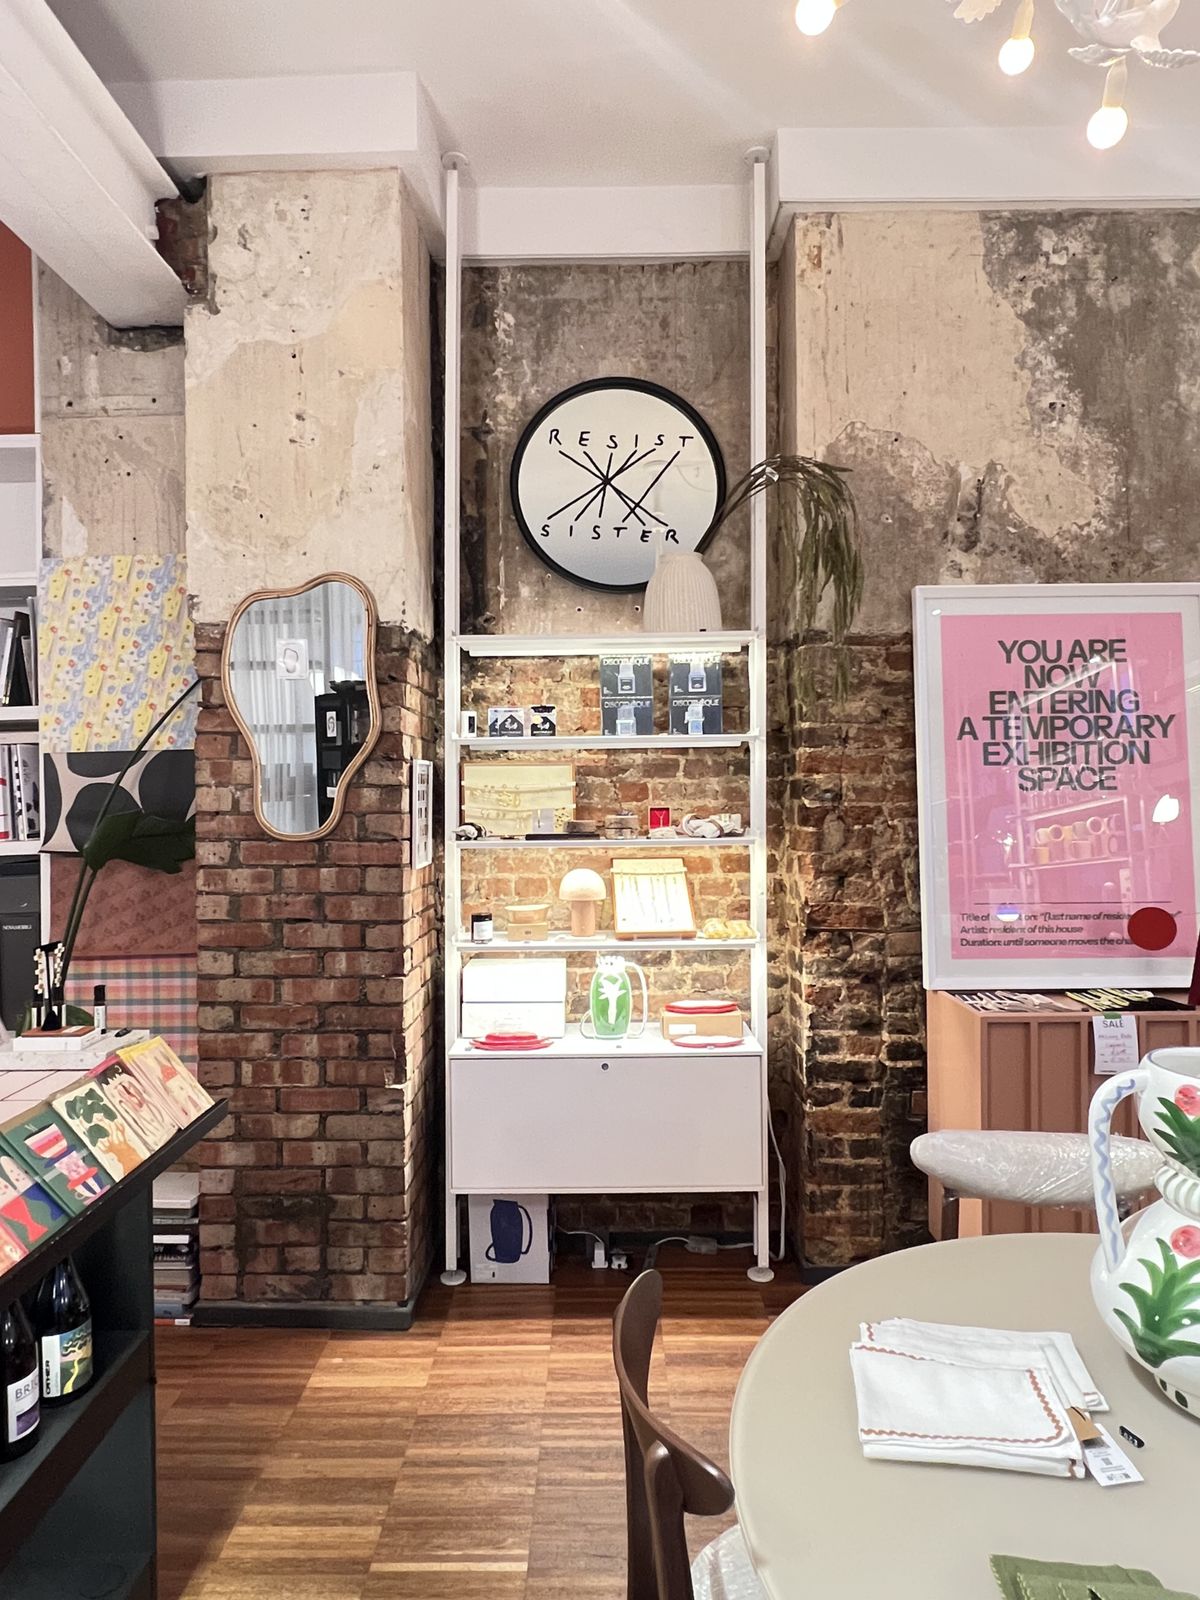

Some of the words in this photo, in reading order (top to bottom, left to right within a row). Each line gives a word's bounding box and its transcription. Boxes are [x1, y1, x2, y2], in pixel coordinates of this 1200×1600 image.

[549, 428, 694, 449] RESIST
[540, 523, 679, 544] SISTER
[998, 639, 1062, 664] YOU
[1068, 638, 1127, 663] ARE
[1025, 664, 1101, 689] NOW
[988, 689, 1140, 714] ENTERING
[957, 716, 979, 741] A
[982, 714, 1176, 740] TEMPORARY
[982, 740, 1150, 766] EXHIBITION
[1018, 766, 1118, 792] SPACE
[960, 912, 980, 922] Title
[980, 912, 990, 921] of
[1092, 912, 1103, 920] of
[960, 925, 988, 934] Artist:
[1027, 924, 1037, 933] of
[1038, 925, 1054, 933] this
[1054, 925, 1084, 933] house
[960, 938, 1002, 947] Duration:
[1003, 937, 1024, 946] until
[1099, 937, 1115, 945] the
[1103, 1020, 1124, 1028] SALE
